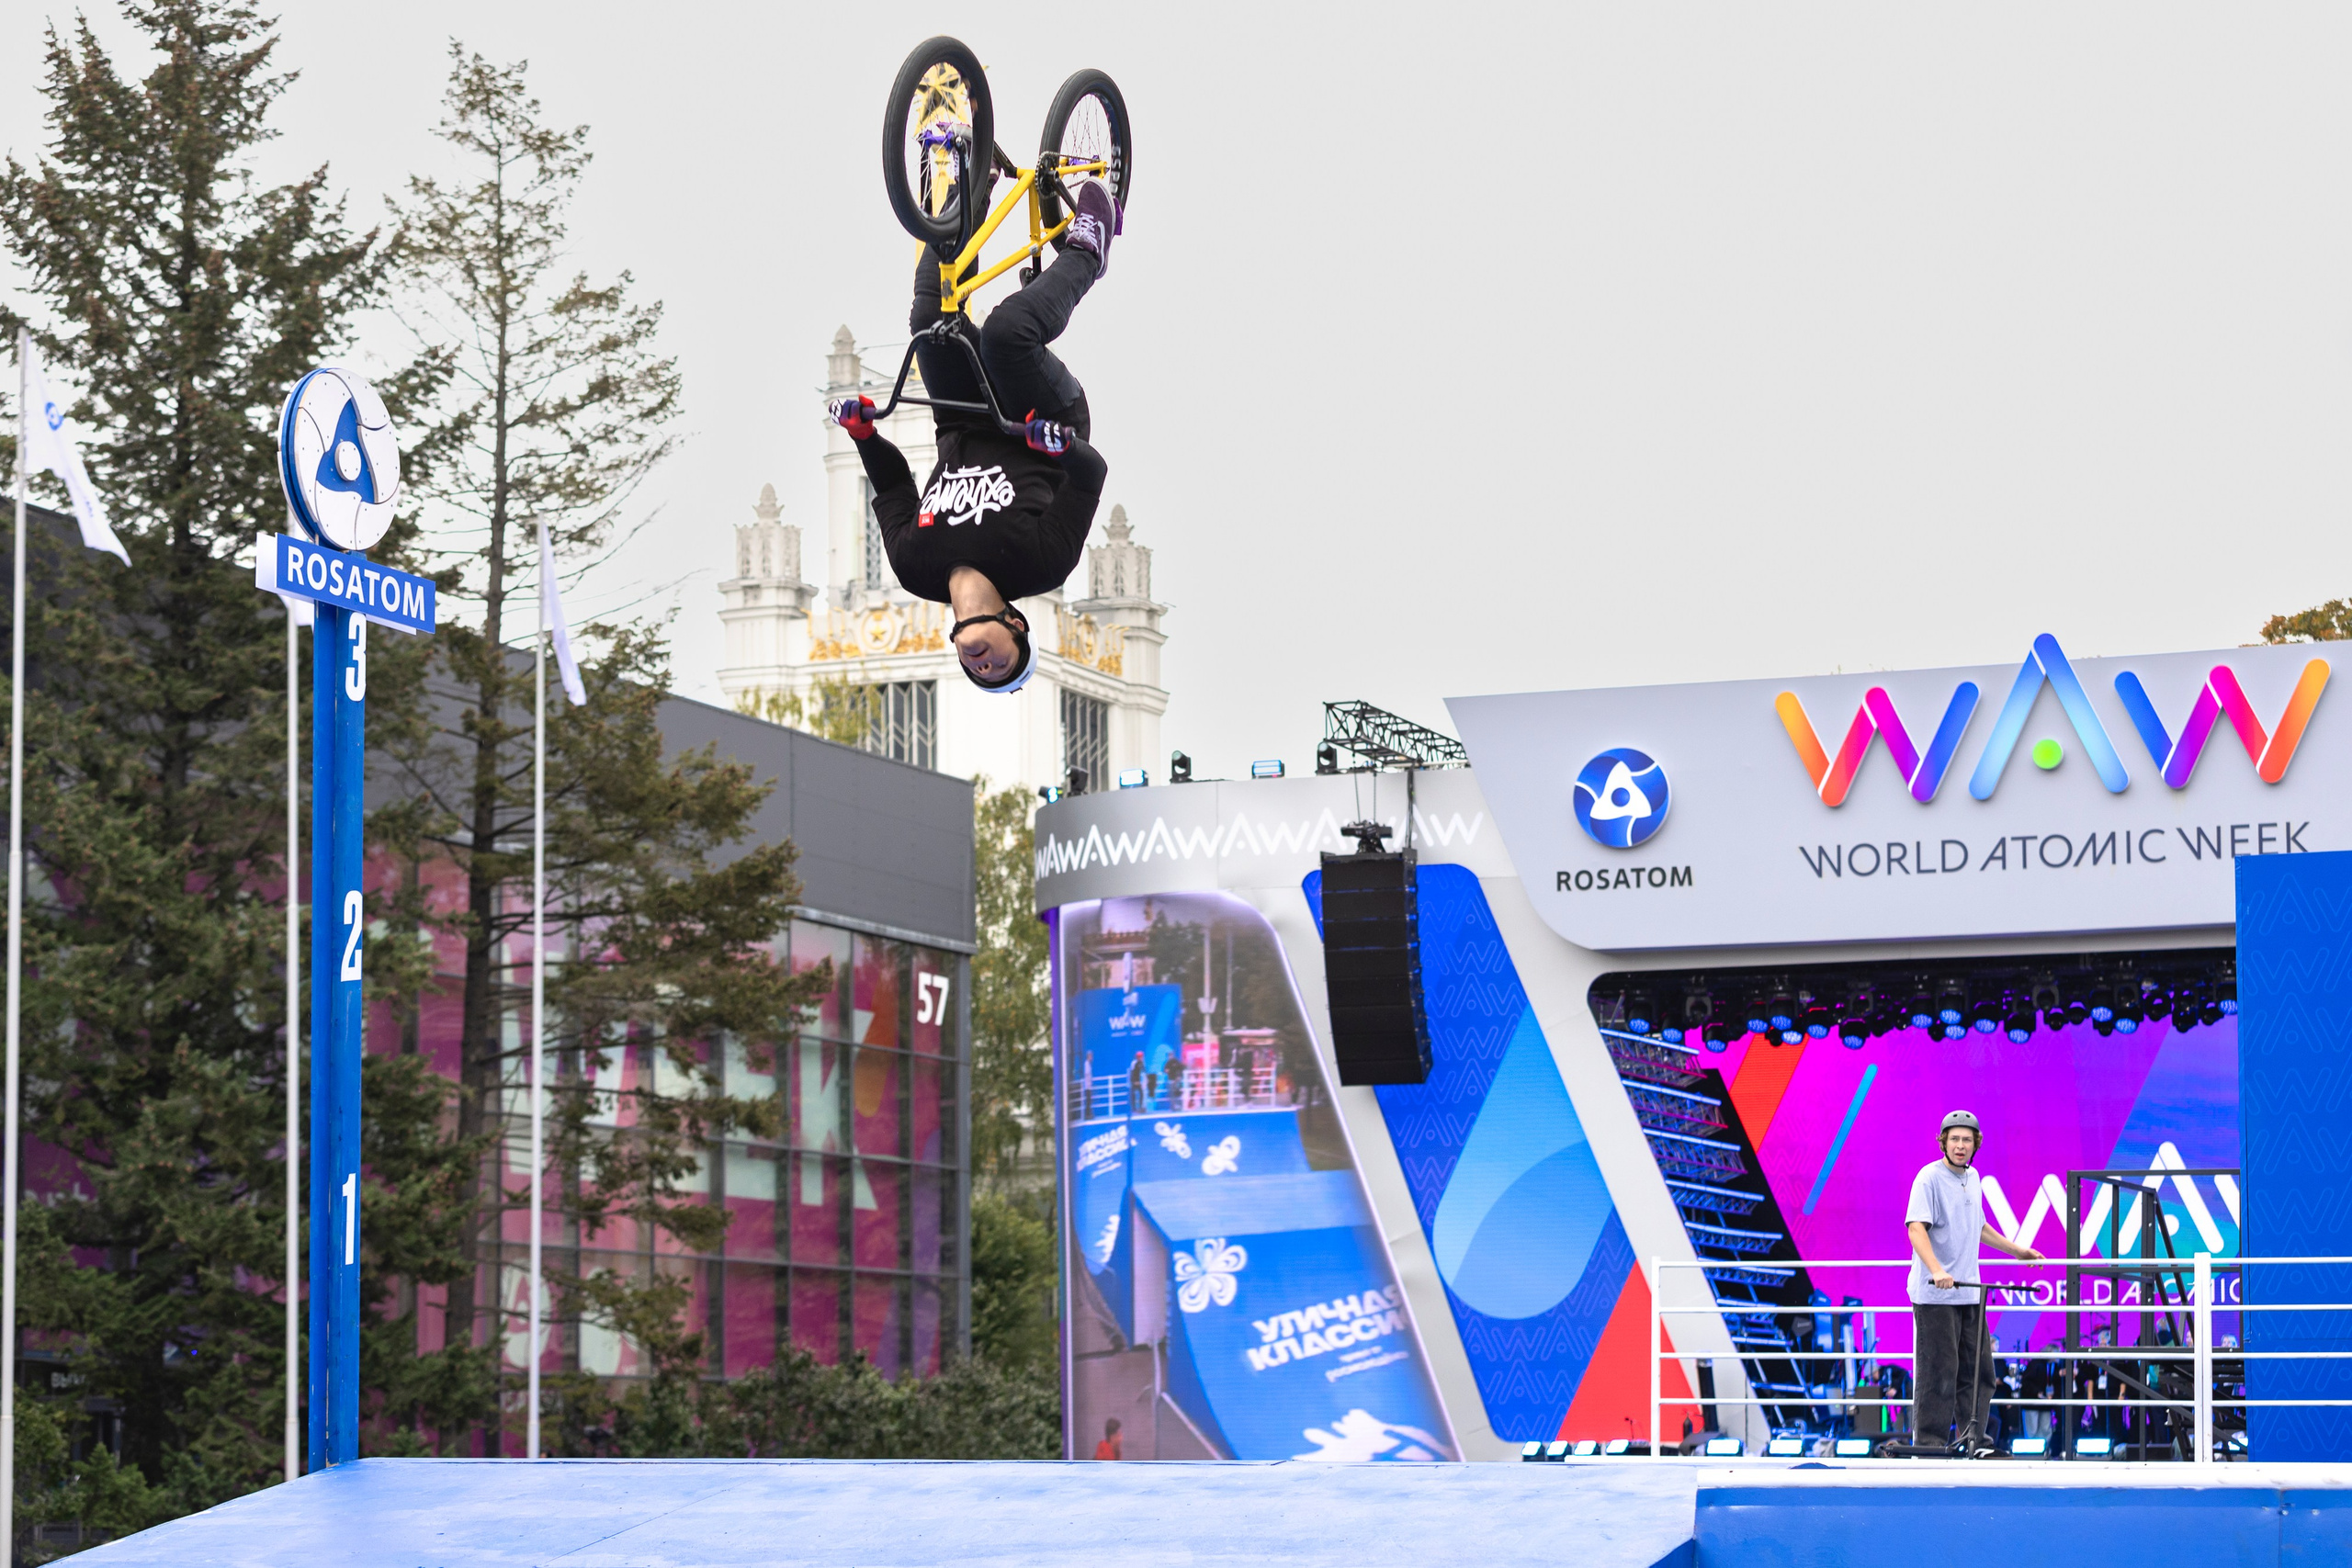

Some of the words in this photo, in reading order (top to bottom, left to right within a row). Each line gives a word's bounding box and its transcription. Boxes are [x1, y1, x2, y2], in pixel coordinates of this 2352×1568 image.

[288, 546, 425, 621] ROSATOM
[345, 612, 367, 701] 3
[1775, 633, 2331, 807] WAW
[1556, 865, 1693, 892] ROSATOM
[1798, 839, 1969, 878] WORLD
[1980, 829, 2166, 872] ATOMIC
[2176, 821, 2310, 861] WEEK
[341, 890, 363, 983] 2
[917, 972, 949, 1026] 57
[343, 1173, 356, 1266] 1
[1980, 1142, 2240, 1256] WA
